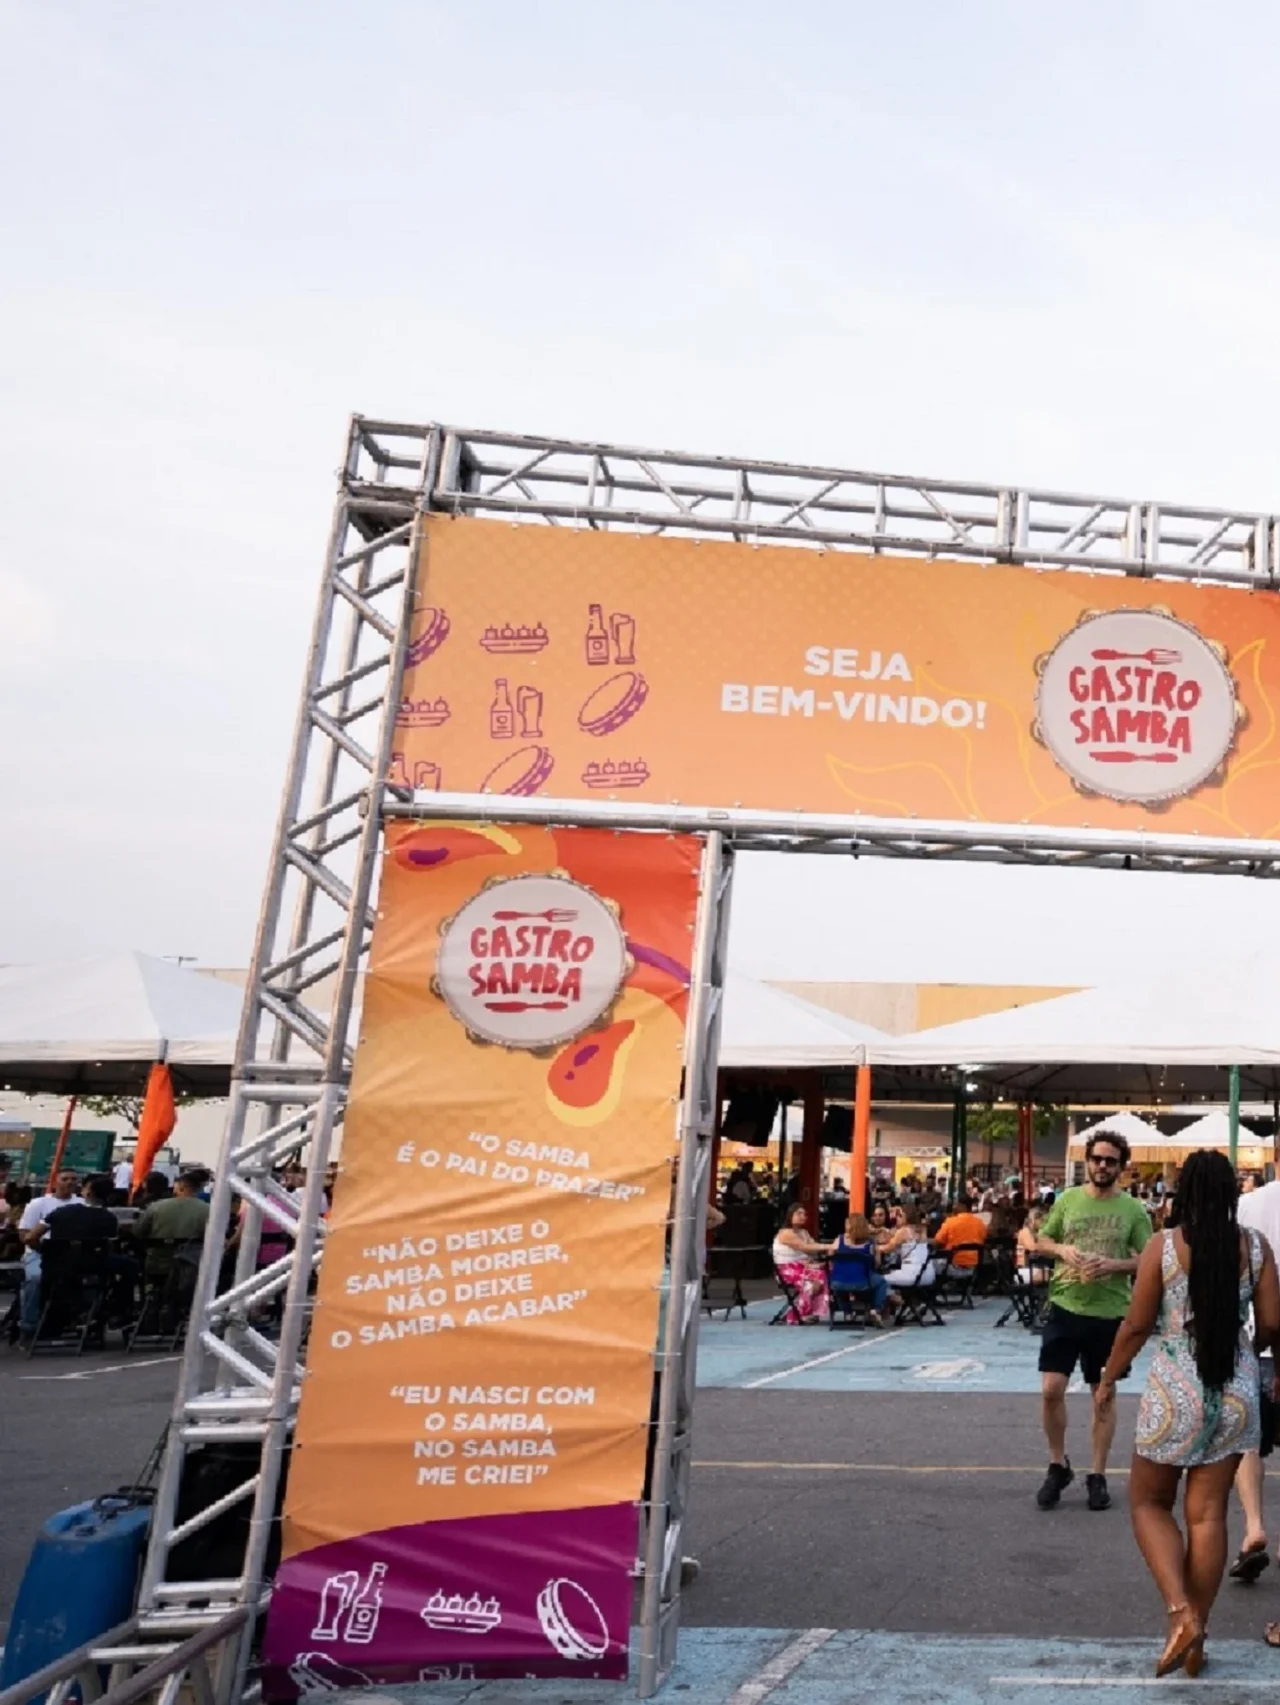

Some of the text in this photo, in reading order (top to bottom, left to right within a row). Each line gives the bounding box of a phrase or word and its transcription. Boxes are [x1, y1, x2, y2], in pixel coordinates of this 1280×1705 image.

[803, 645, 913, 683] SEJA
[720, 684, 988, 729] BEM-VINDO!
[1069, 665, 1201, 711] GASTRO
[1070, 706, 1192, 753] SAMBA
[470, 926, 594, 962] GASTRO
[468, 962, 582, 1001] SAMBA
[468, 1131, 590, 1169] “O SAMBA
[396, 1141, 645, 1201] É O PAI DO PRAZER”
[362, 1219, 549, 1263] “NÃO DEIXE O
[345, 1242, 569, 1294] SAMBA MORRER,
[385, 1274, 532, 1314] NÃO DEIXE
[331, 1289, 588, 1349] O SAMBA ACABAR”
[389, 1386, 595, 1405] “EU NASCI COM
[425, 1413, 552, 1434] O SAMBA,
[413, 1439, 557, 1458] NO SAMBA
[417, 1464, 548, 1485] ME CRIEI”
